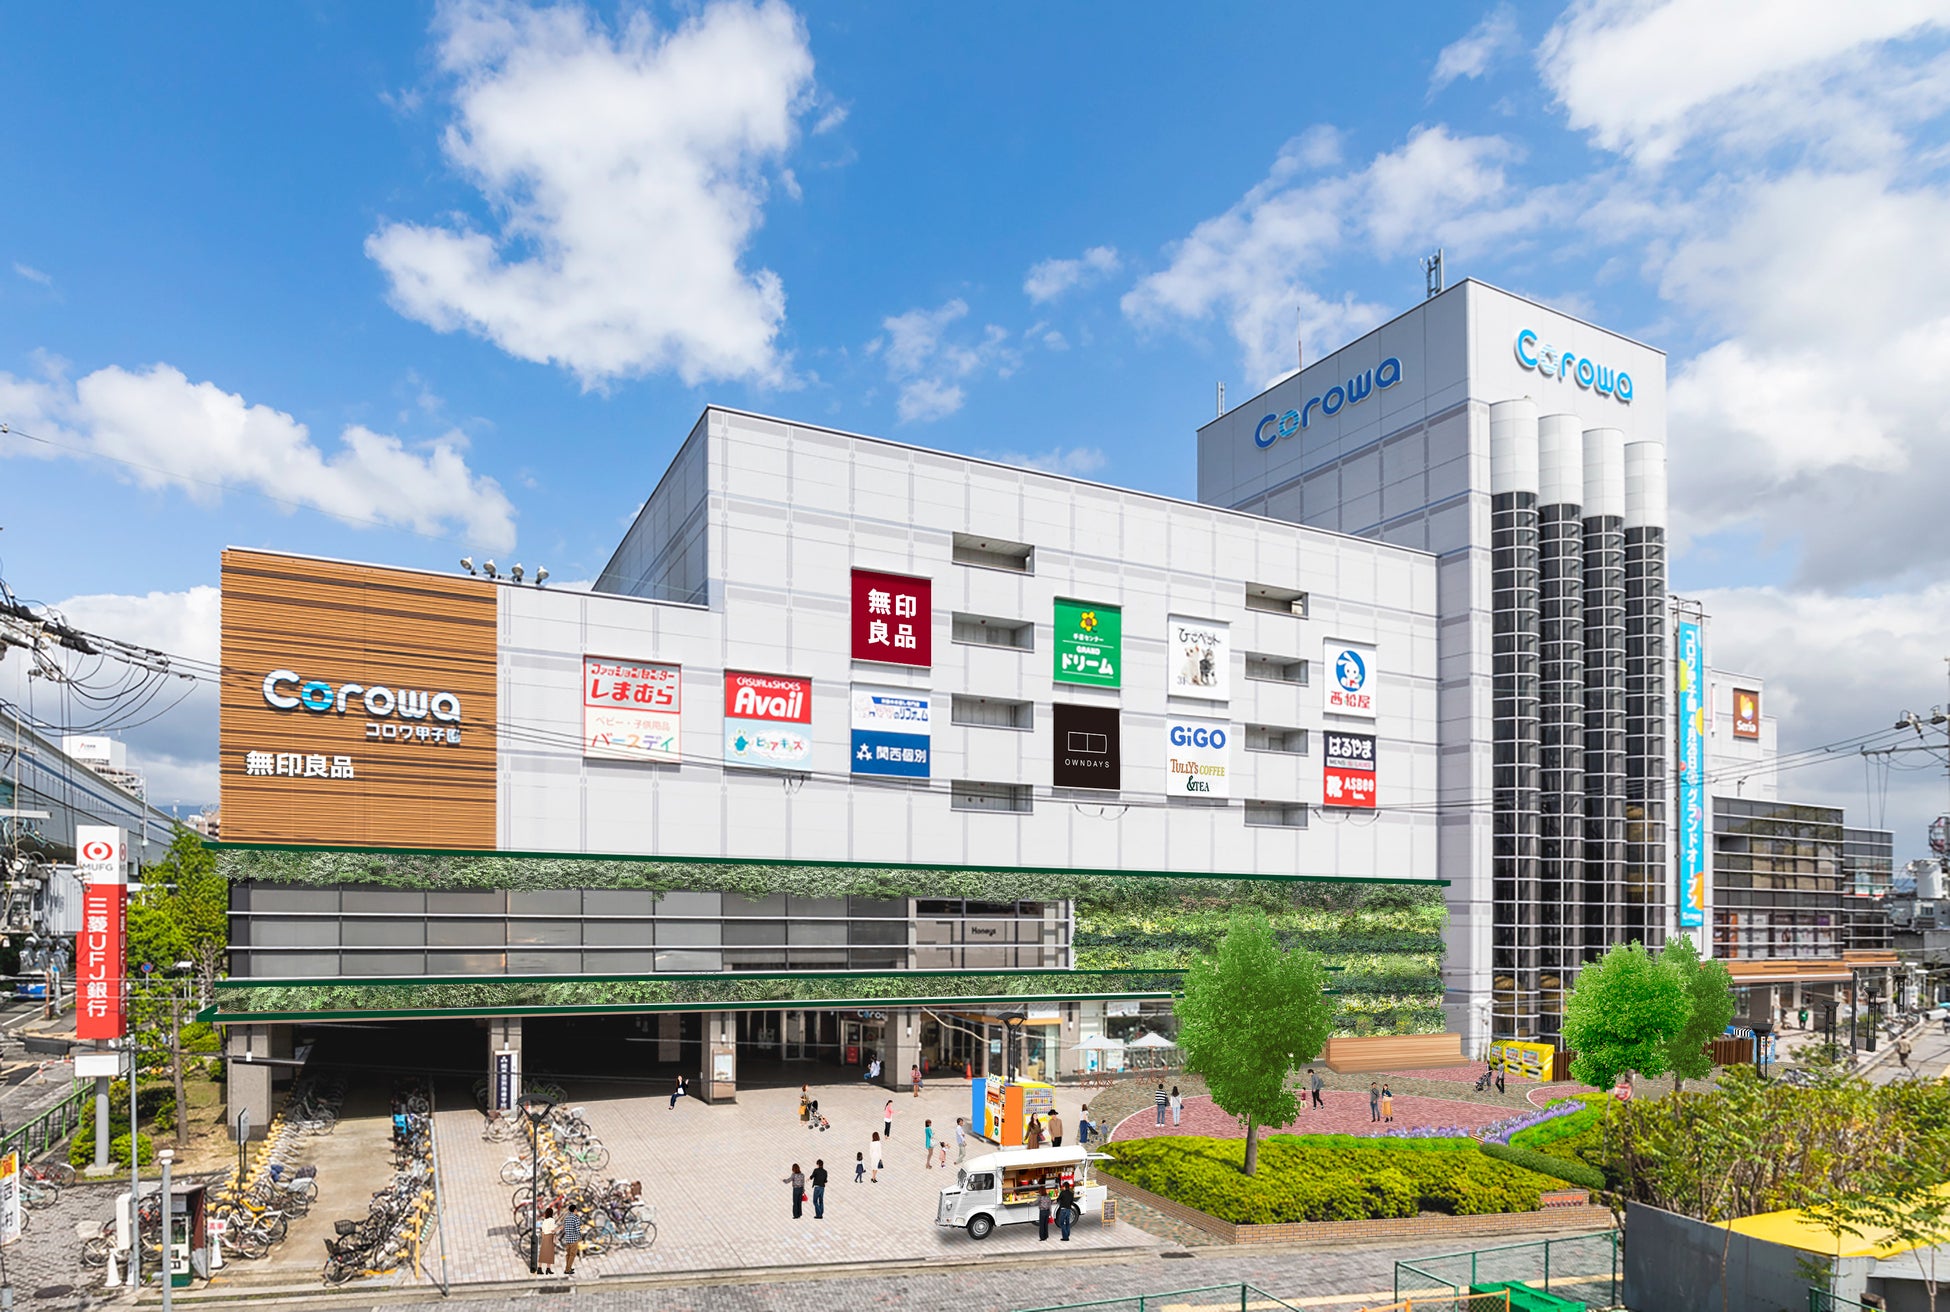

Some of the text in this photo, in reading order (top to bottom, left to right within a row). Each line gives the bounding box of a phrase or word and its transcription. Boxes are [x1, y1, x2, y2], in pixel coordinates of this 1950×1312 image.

[1515, 329, 1634, 404] Corowa
[1254, 356, 1403, 449] Corowa
[868, 588, 917, 619] 無印
[868, 619, 916, 649] 良品
[591, 663, 675, 681] ファッションセンター
[1062, 653, 1114, 675] ドリーム
[262, 669, 461, 723] Corowa
[591, 679, 675, 705] しまむら
[734, 686, 804, 719] Avail
[1330, 691, 1371, 709] 西松屋
[1170, 726, 1226, 750] GiGO
[1736, 720, 1757, 733] Seria
[592, 732, 674, 752] バースデイ
[1329, 736, 1372, 758] はるやま
[246, 750, 354, 779] 無印良品
[876, 745, 927, 764] 関西個別
[1064, 759, 1110, 769] OWNDAYS
[1199, 765, 1226, 777] COFFEE
[82, 862, 114, 872] MUFG
[87, 897, 109, 1018] 三菱UFJ銀行
